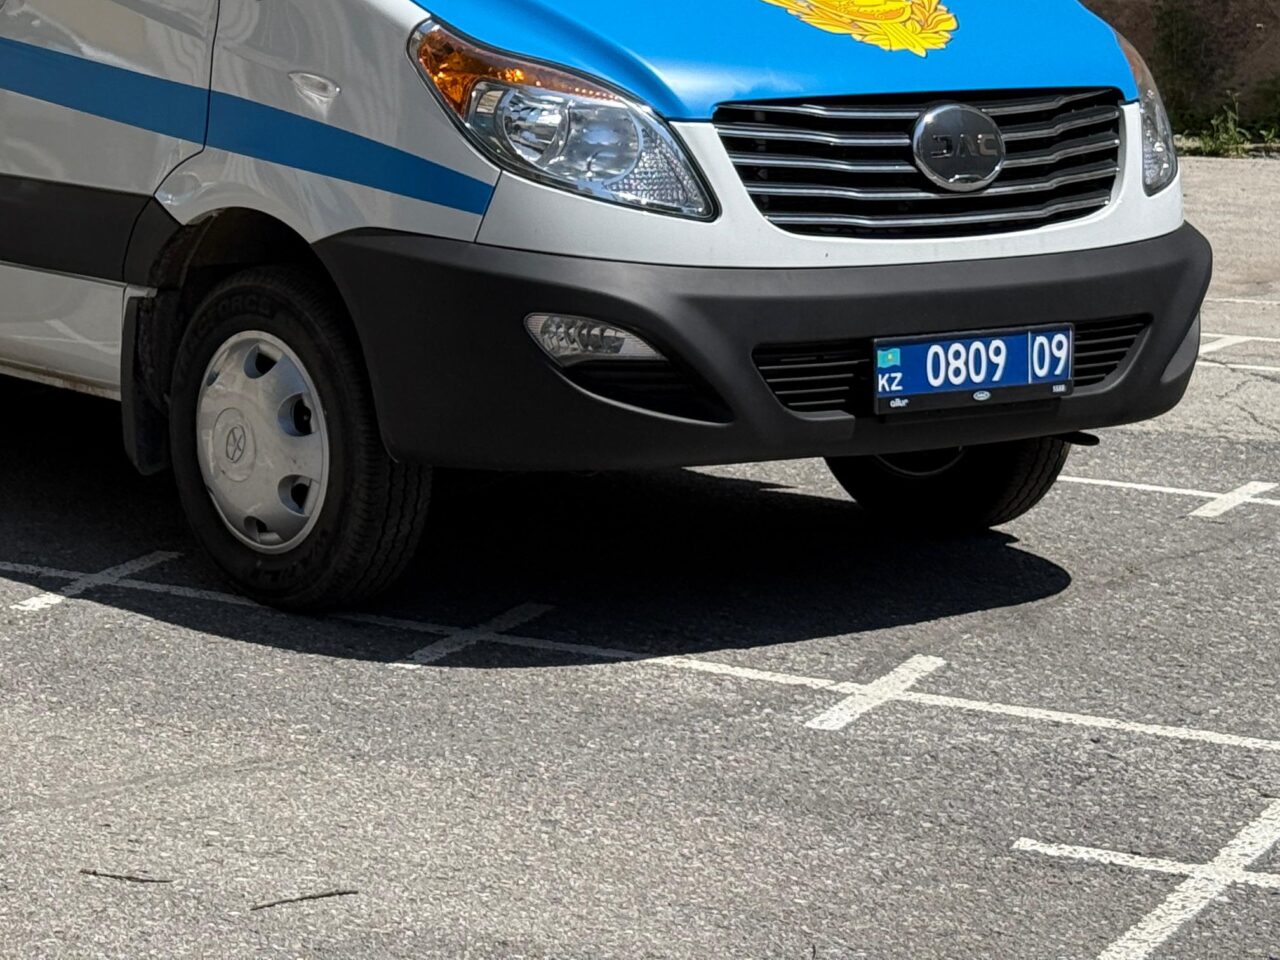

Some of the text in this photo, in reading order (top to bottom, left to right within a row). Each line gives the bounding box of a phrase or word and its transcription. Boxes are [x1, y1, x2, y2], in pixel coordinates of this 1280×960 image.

[878, 333, 1069, 392] KZ 0809 09
